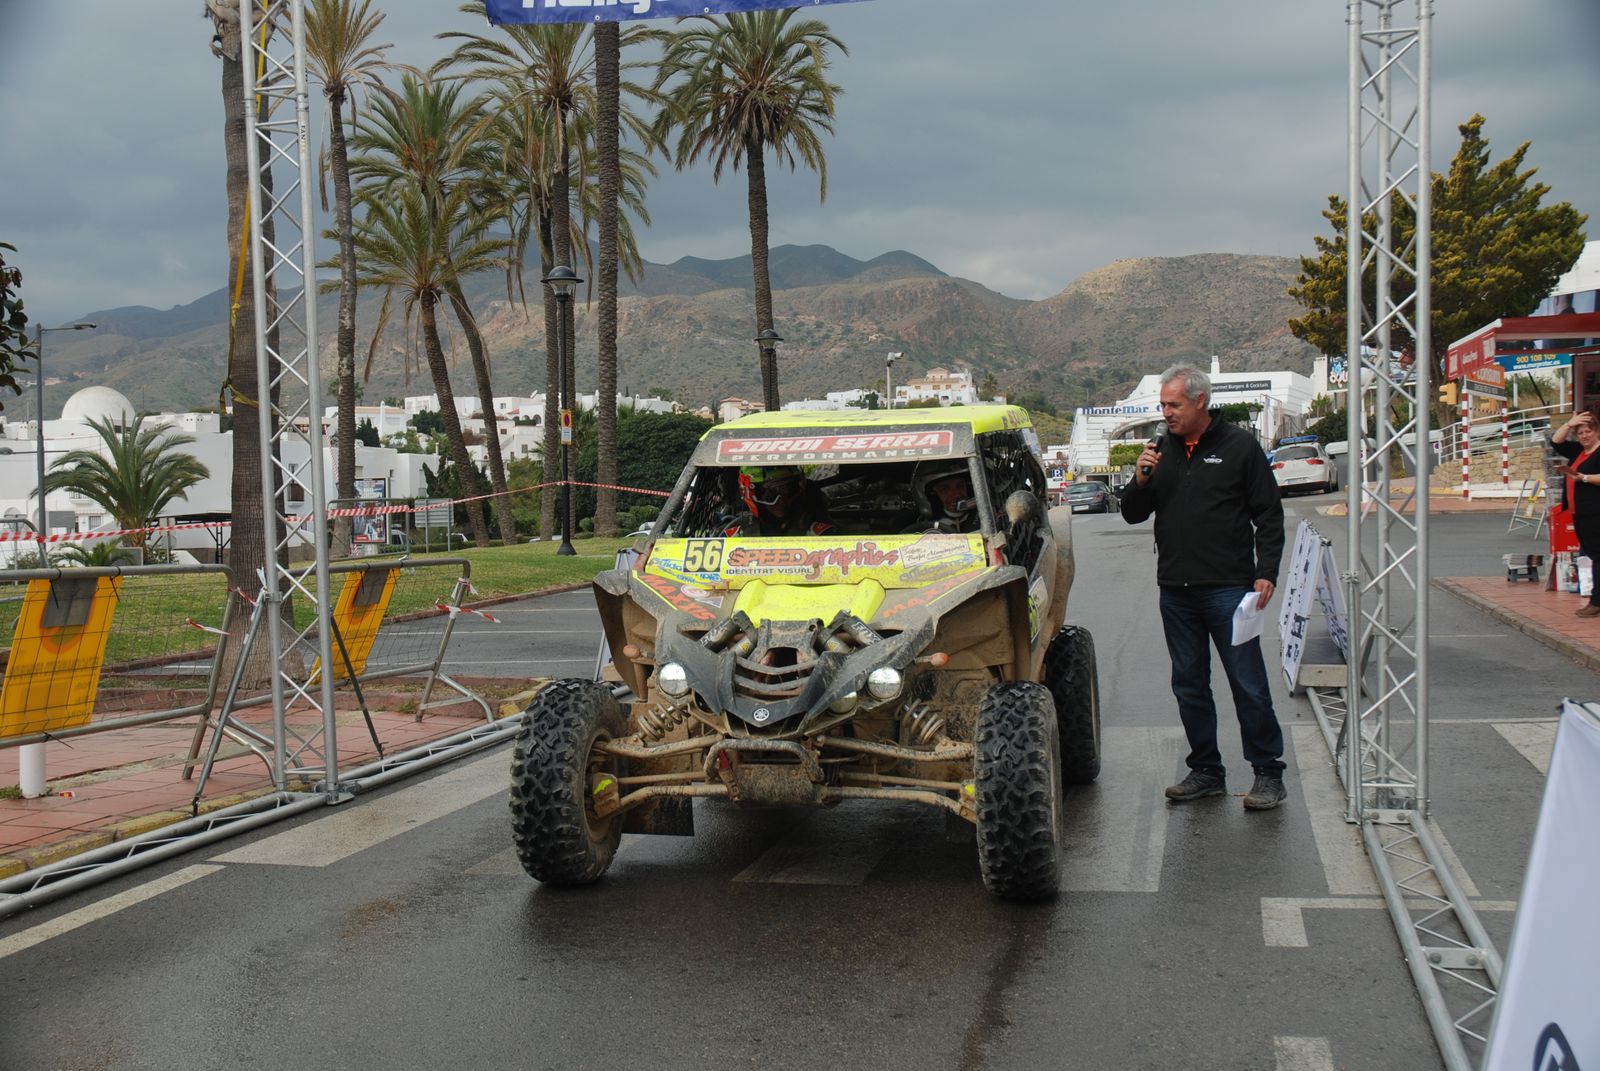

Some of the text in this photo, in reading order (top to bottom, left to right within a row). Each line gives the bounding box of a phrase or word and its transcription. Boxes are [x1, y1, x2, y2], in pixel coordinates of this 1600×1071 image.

[728, 433, 940, 453] JORDI SERRA
[731, 448, 934, 461] PERFORMANCE
[685, 540, 723, 572] 56
[779, 567, 812, 575] VISUAL
